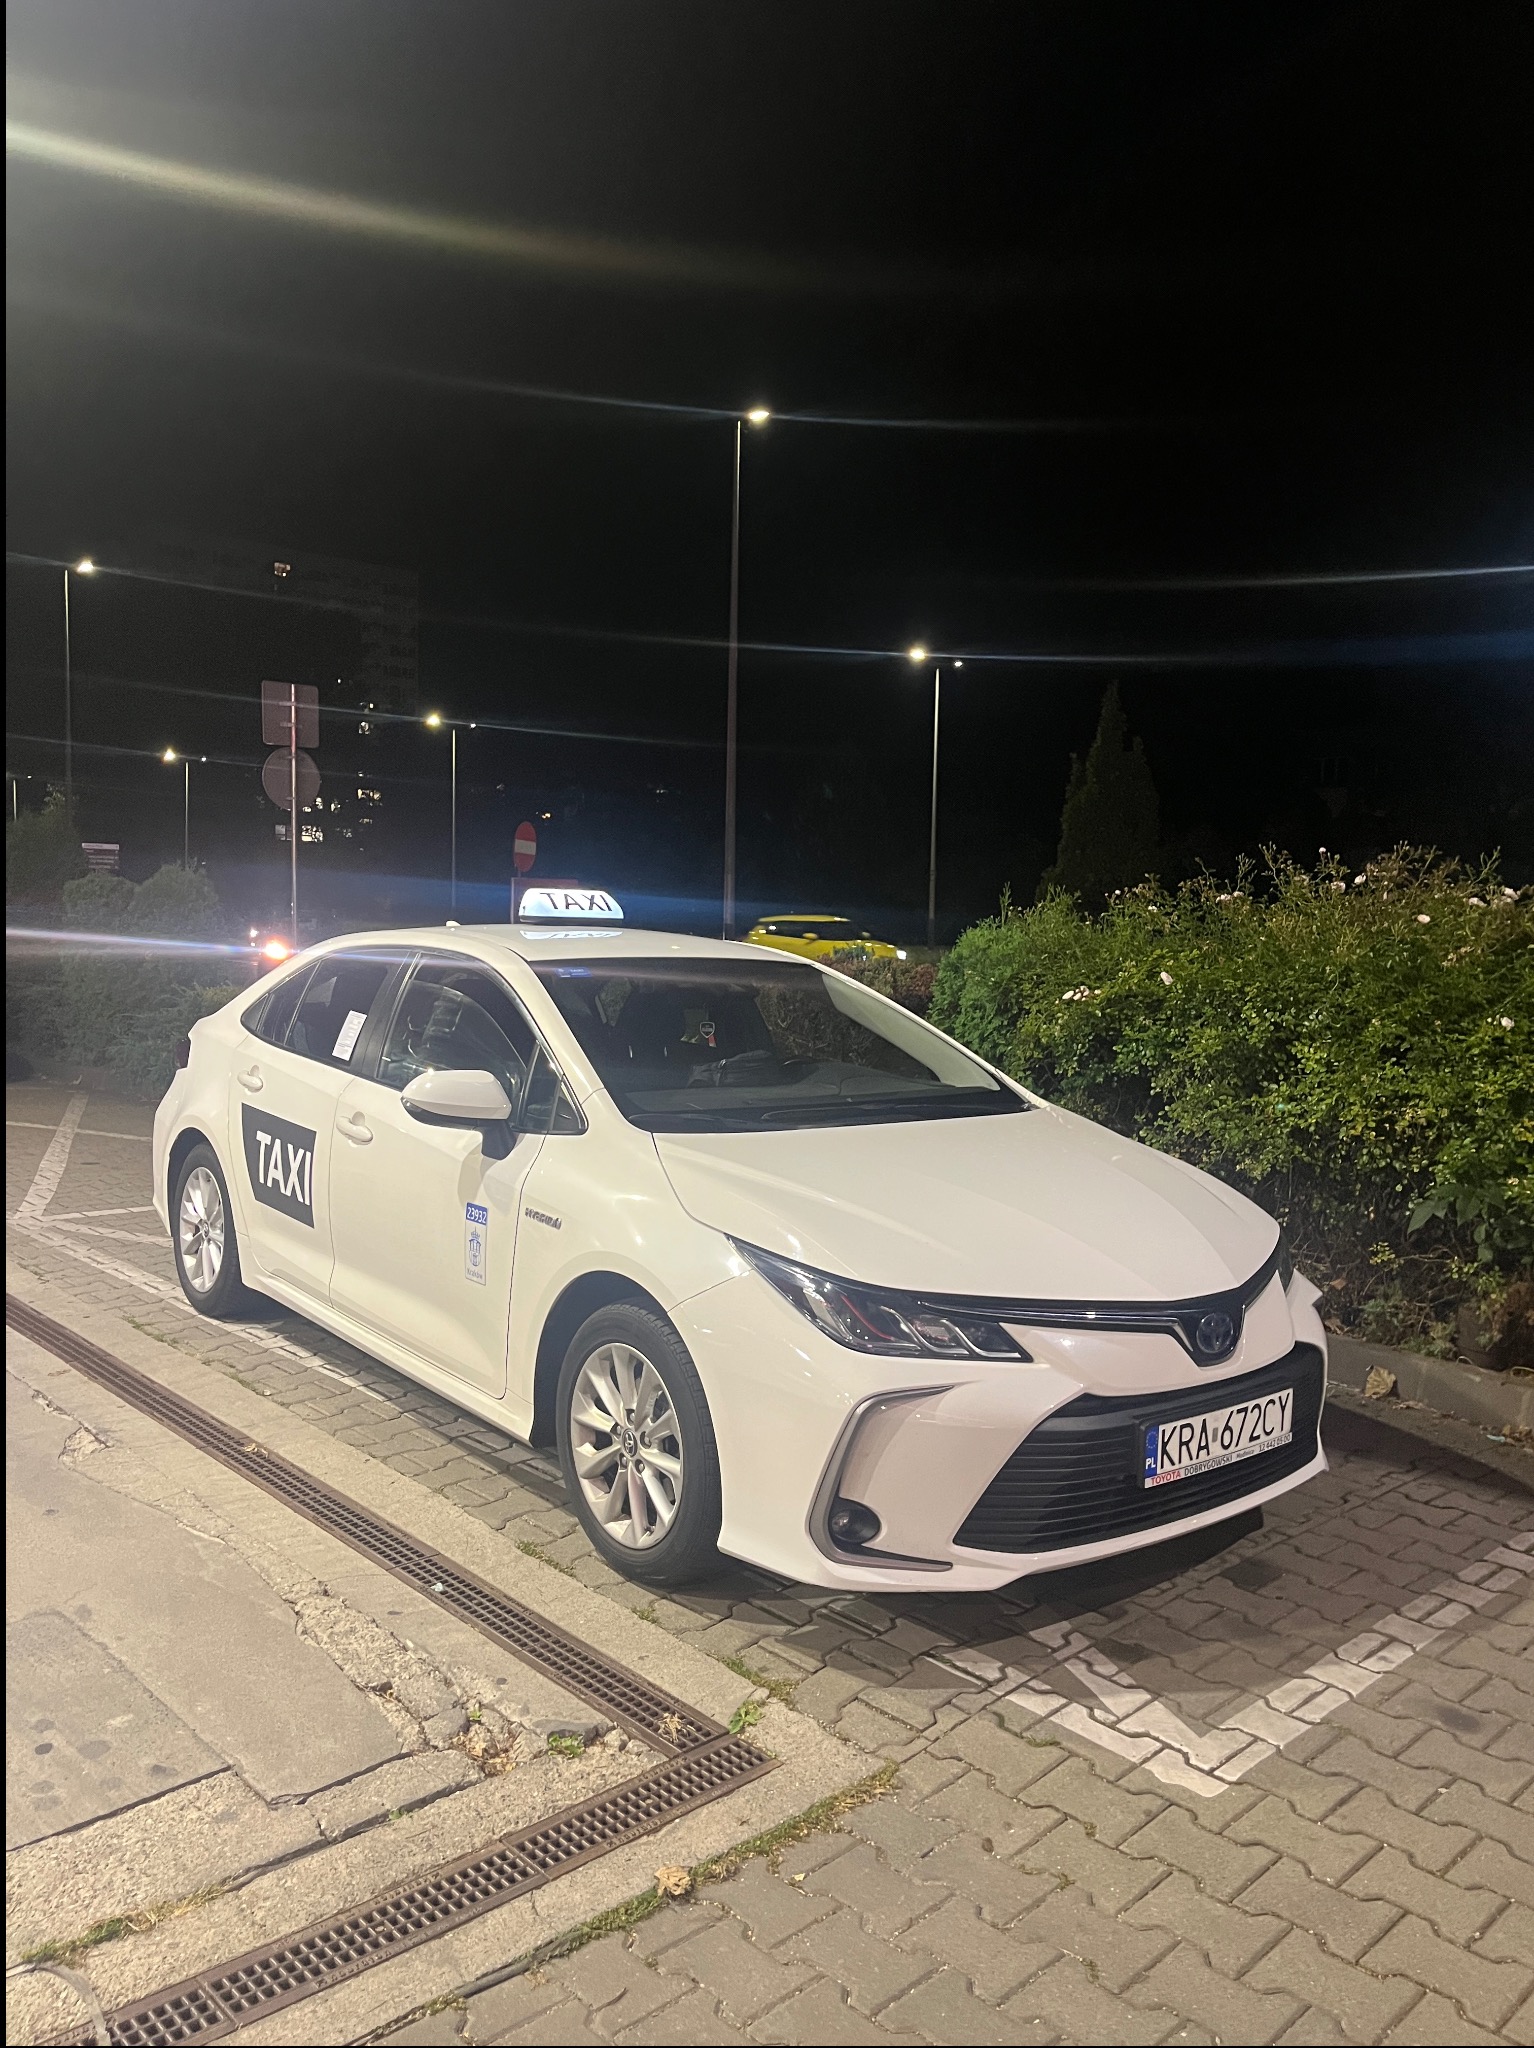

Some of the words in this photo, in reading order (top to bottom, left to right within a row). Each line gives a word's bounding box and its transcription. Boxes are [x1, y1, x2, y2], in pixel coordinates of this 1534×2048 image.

[540, 892, 612, 912] TAXI
[256, 1130, 311, 1206] TAXI
[467, 1206, 487, 1224] 23932
[1159, 1418, 1211, 1470] KRA
[1220, 1392, 1291, 1450] 672CY
[1145, 1457, 1157, 1470] PL
[1151, 1470, 1182, 1486] TOYOTA
[1184, 1455, 1233, 1476] DOBRYGOWSKI
